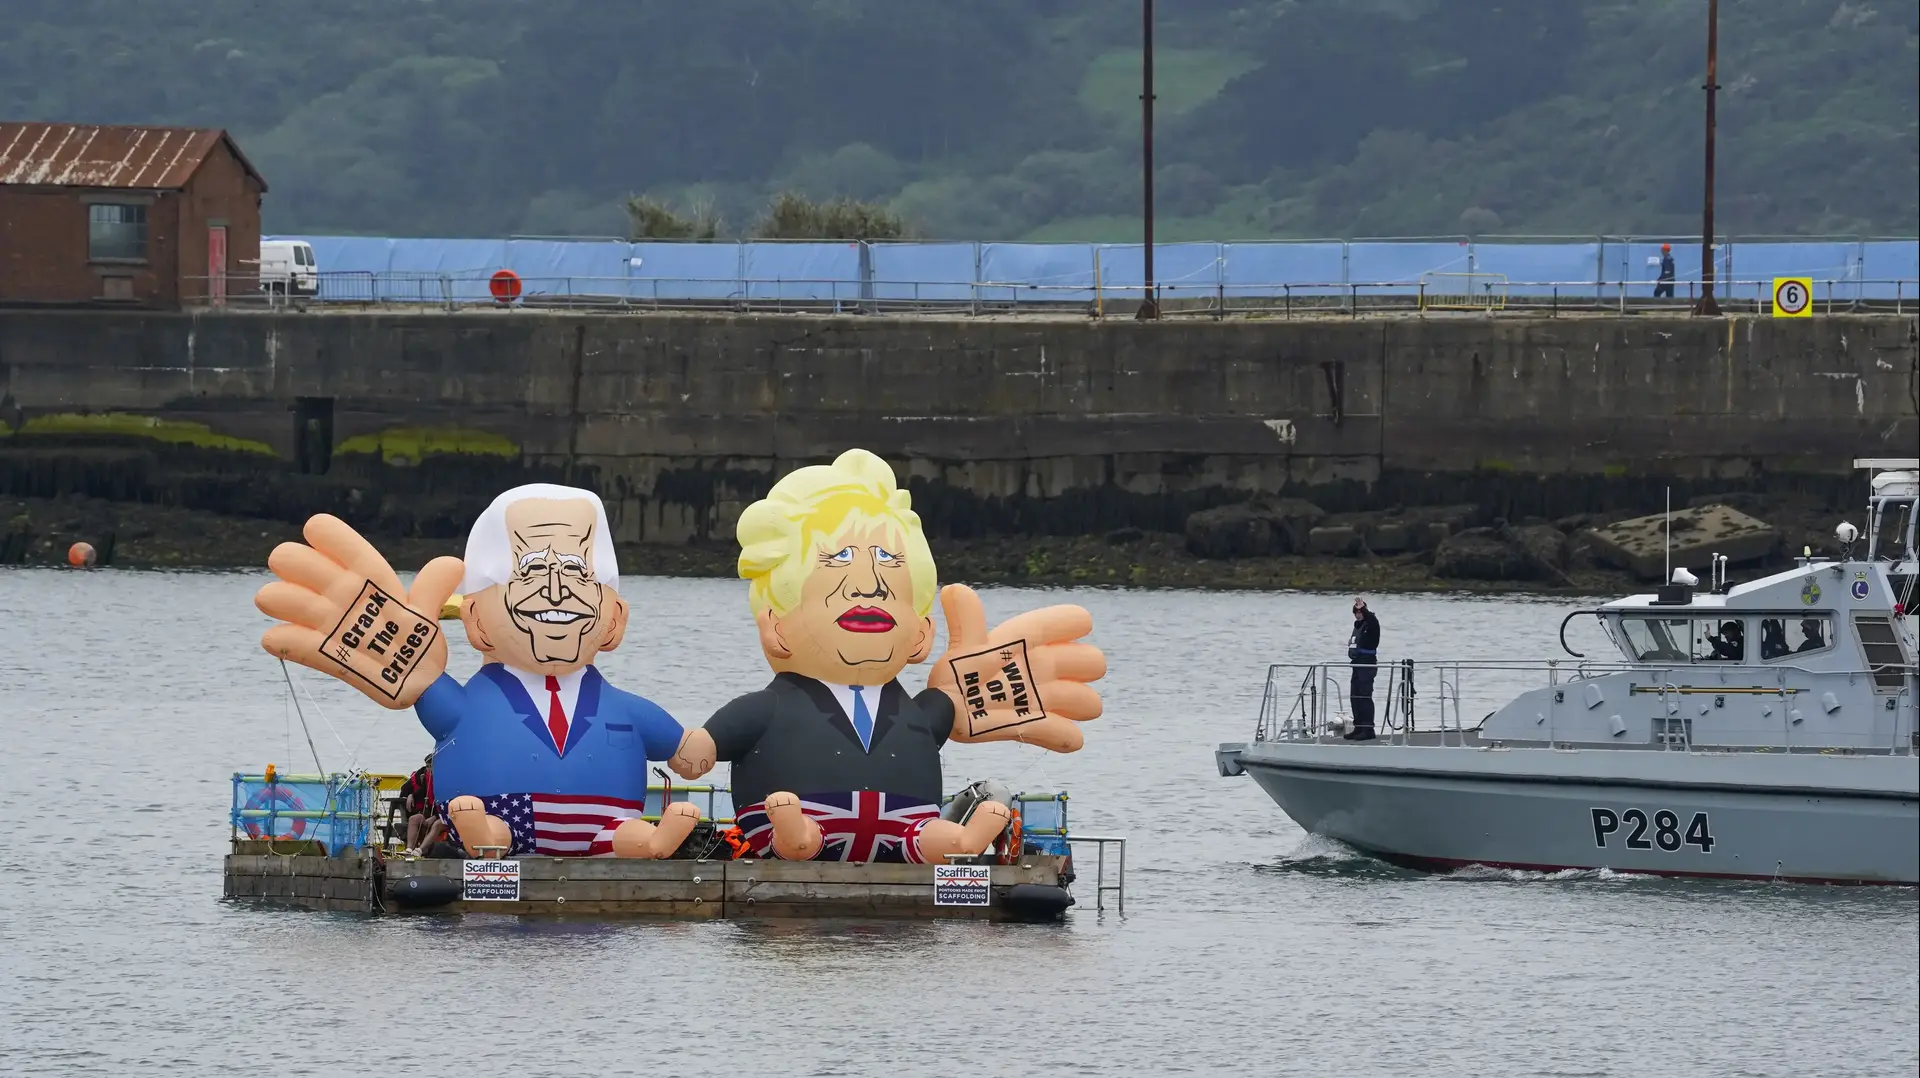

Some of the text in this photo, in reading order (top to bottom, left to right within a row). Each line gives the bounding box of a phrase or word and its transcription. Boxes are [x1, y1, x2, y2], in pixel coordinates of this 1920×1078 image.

[1787, 285, 1798, 304] 6
[336, 591, 388, 662] #Crack
[367, 620, 399, 655] The
[381, 622, 429, 684] Crises
[963, 671, 988, 720] HOPE
[986, 679, 1007, 703] OF
[1000, 649, 1031, 717] #WAVE
[1590, 807, 1716, 854] P284
[465, 862, 519, 873] ScaffFloat
[936, 867, 989, 878] ScaffFloat
